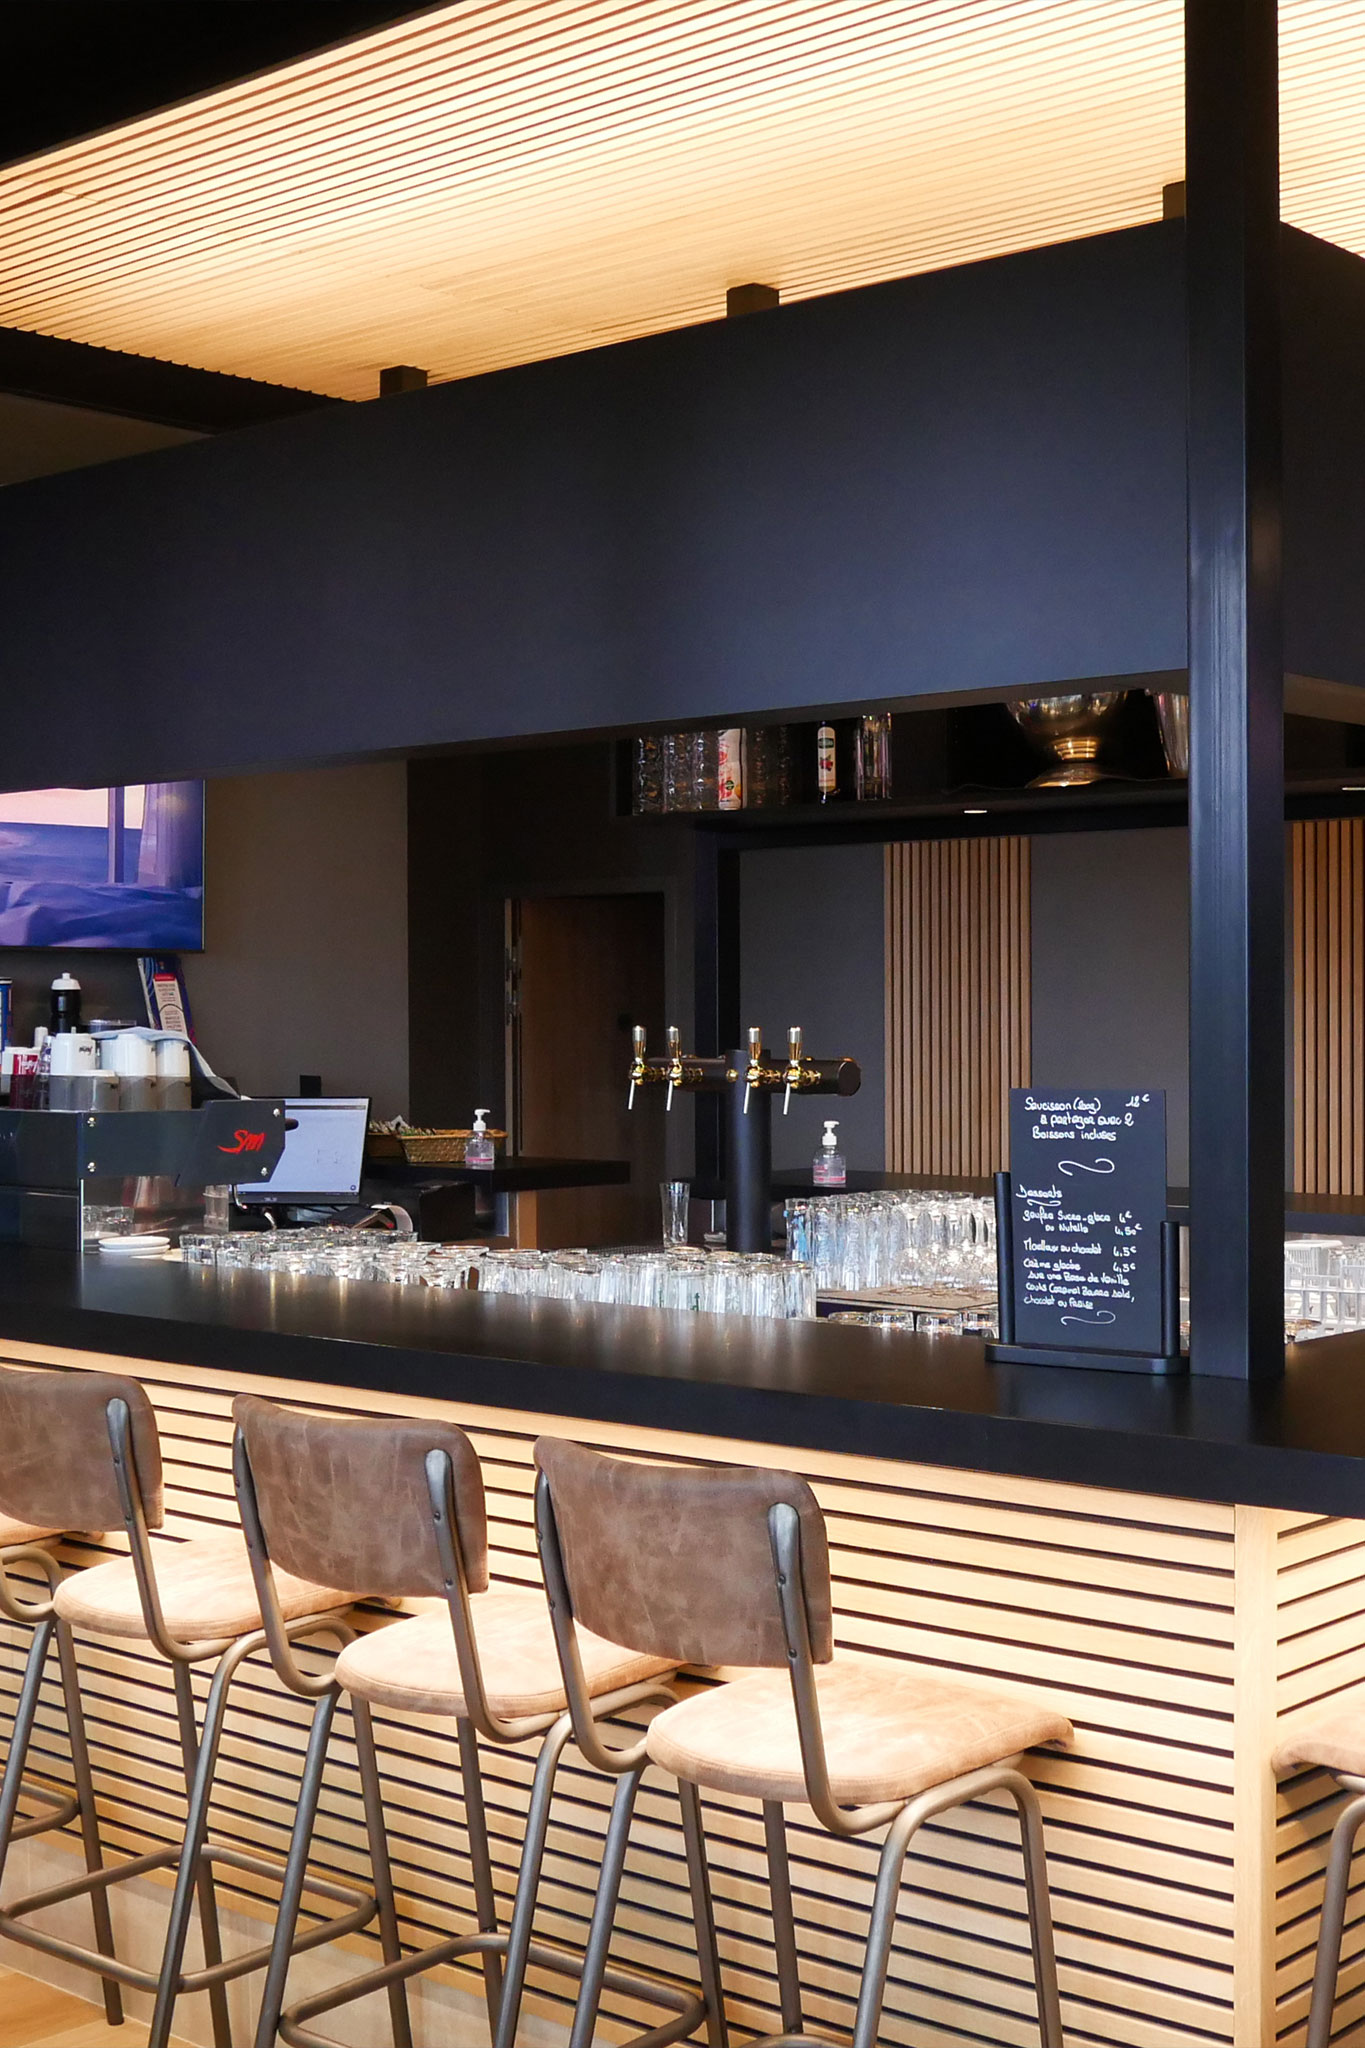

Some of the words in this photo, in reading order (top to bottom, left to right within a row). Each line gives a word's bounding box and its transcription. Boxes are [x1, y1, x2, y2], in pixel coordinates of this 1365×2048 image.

[1025, 1096, 1072, 1111] Saucisson
[1050, 1111, 1095, 1129] partager
[1097, 1116, 1122, 1125] avec
[1124, 1112, 1134, 1126] 2
[1032, 1126, 1075, 1139] Boissons
[1081, 1128, 1116, 1141] incluses
[1015, 1184, 1063, 1199] Desserts
[1058, 1222, 1089, 1234] Nutella
[1023, 1237, 1059, 1253] Moelleux
[1060, 1245, 1072, 1253] au
[1087, 1272, 1100, 1283] de
